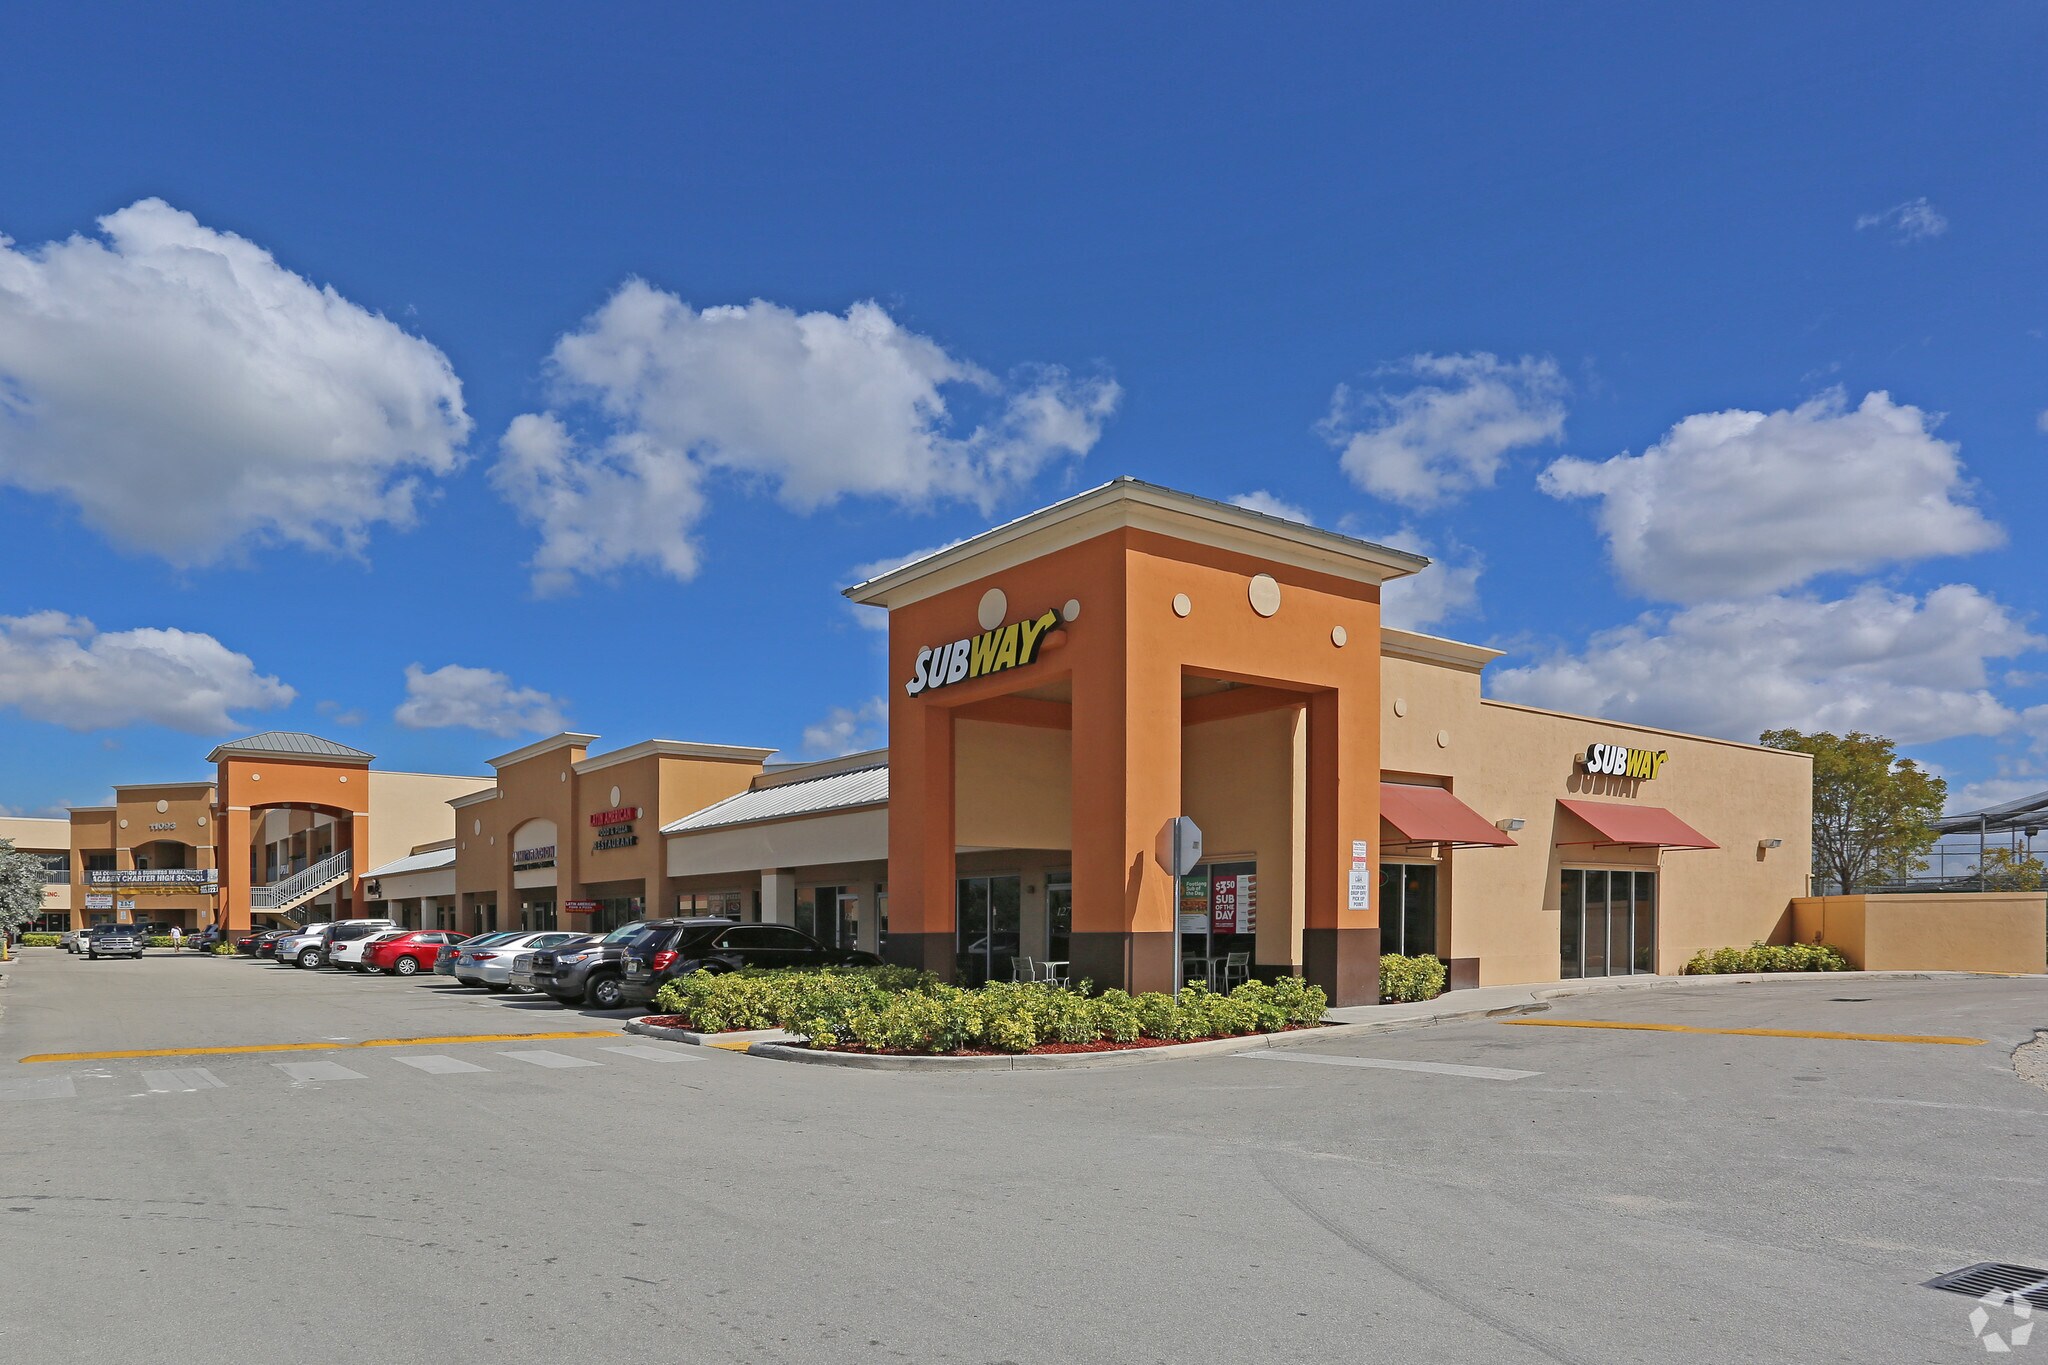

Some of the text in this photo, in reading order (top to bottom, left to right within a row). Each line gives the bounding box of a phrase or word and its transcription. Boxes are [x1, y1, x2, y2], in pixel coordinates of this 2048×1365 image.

[905, 608, 1062, 697] SUBWAY
[1587, 743, 1669, 780] SUBWAY
[605, 808, 631, 825] AMERICAN
[149, 821, 176, 830] 11093
[593, 836, 633, 850] RESTAURANT
[175, 874, 205, 882] SCHOOL
[1216, 895, 1235, 904] SUB
[1216, 911, 1235, 920] DAY
